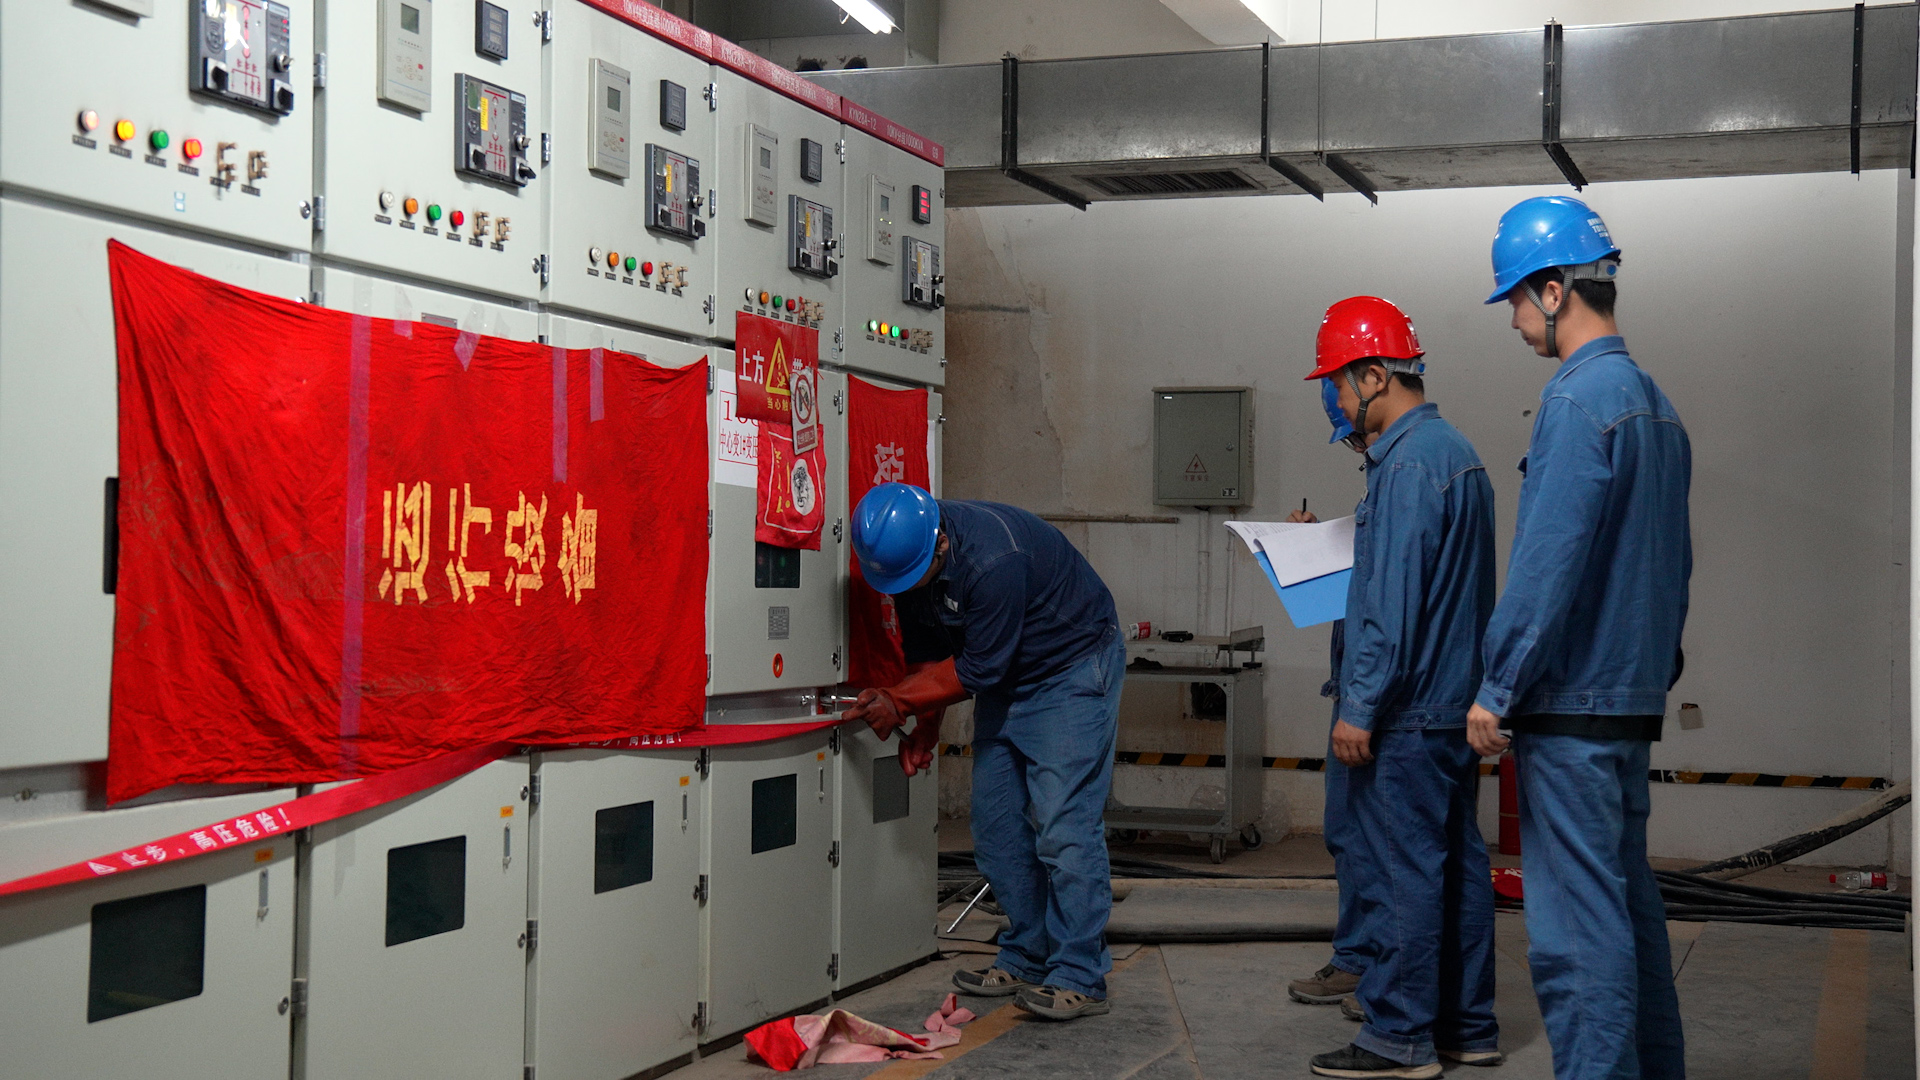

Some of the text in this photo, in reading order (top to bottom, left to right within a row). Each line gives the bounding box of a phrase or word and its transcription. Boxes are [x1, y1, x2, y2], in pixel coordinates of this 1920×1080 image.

[848, 107, 877, 130] KYN28A-12
[739, 347, 765, 385] 上方
[767, 396, 791, 412] 当心触
[377, 480, 598, 606] 运行设备
